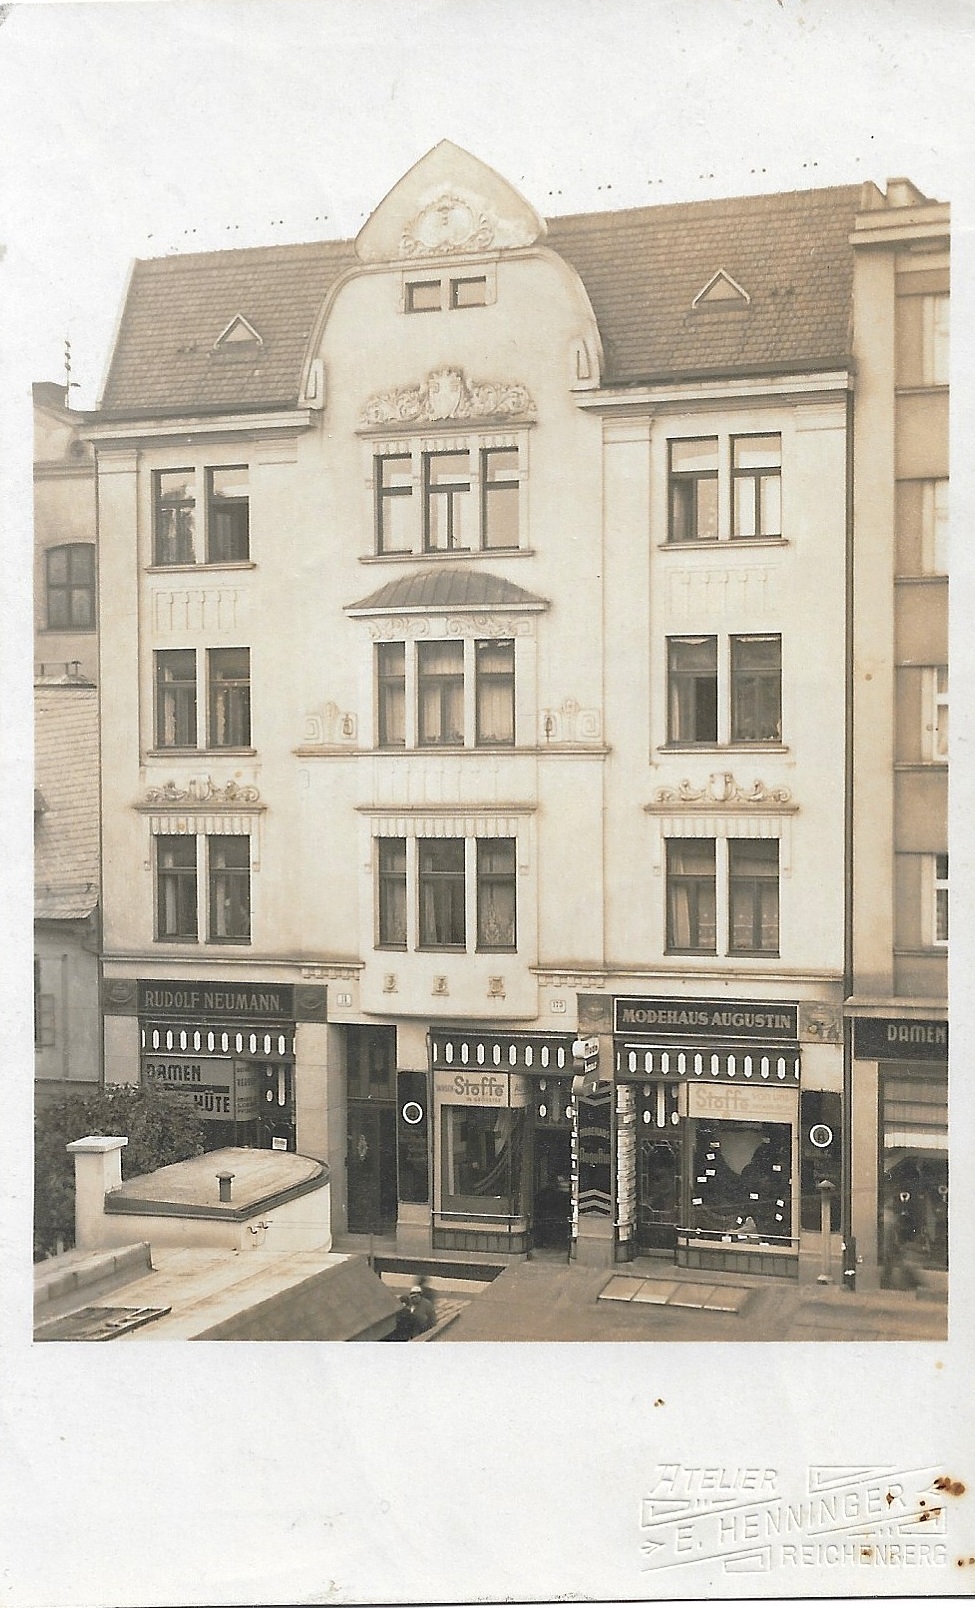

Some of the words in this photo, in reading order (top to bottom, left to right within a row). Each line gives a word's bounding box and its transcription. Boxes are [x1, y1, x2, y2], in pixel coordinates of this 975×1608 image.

[144, 990, 199, 1009] RUDOLF
[622, 1008, 709, 1026] MODEHAUS
[711, 1011, 791, 1029] AUGUSTIN
[886, 1024, 947, 1043] DAMEN
[146, 1063, 201, 1081] DAMEN
[454, 1075, 504, 1097] Stoffe
[695, 1087, 750, 1109] Stoffe
